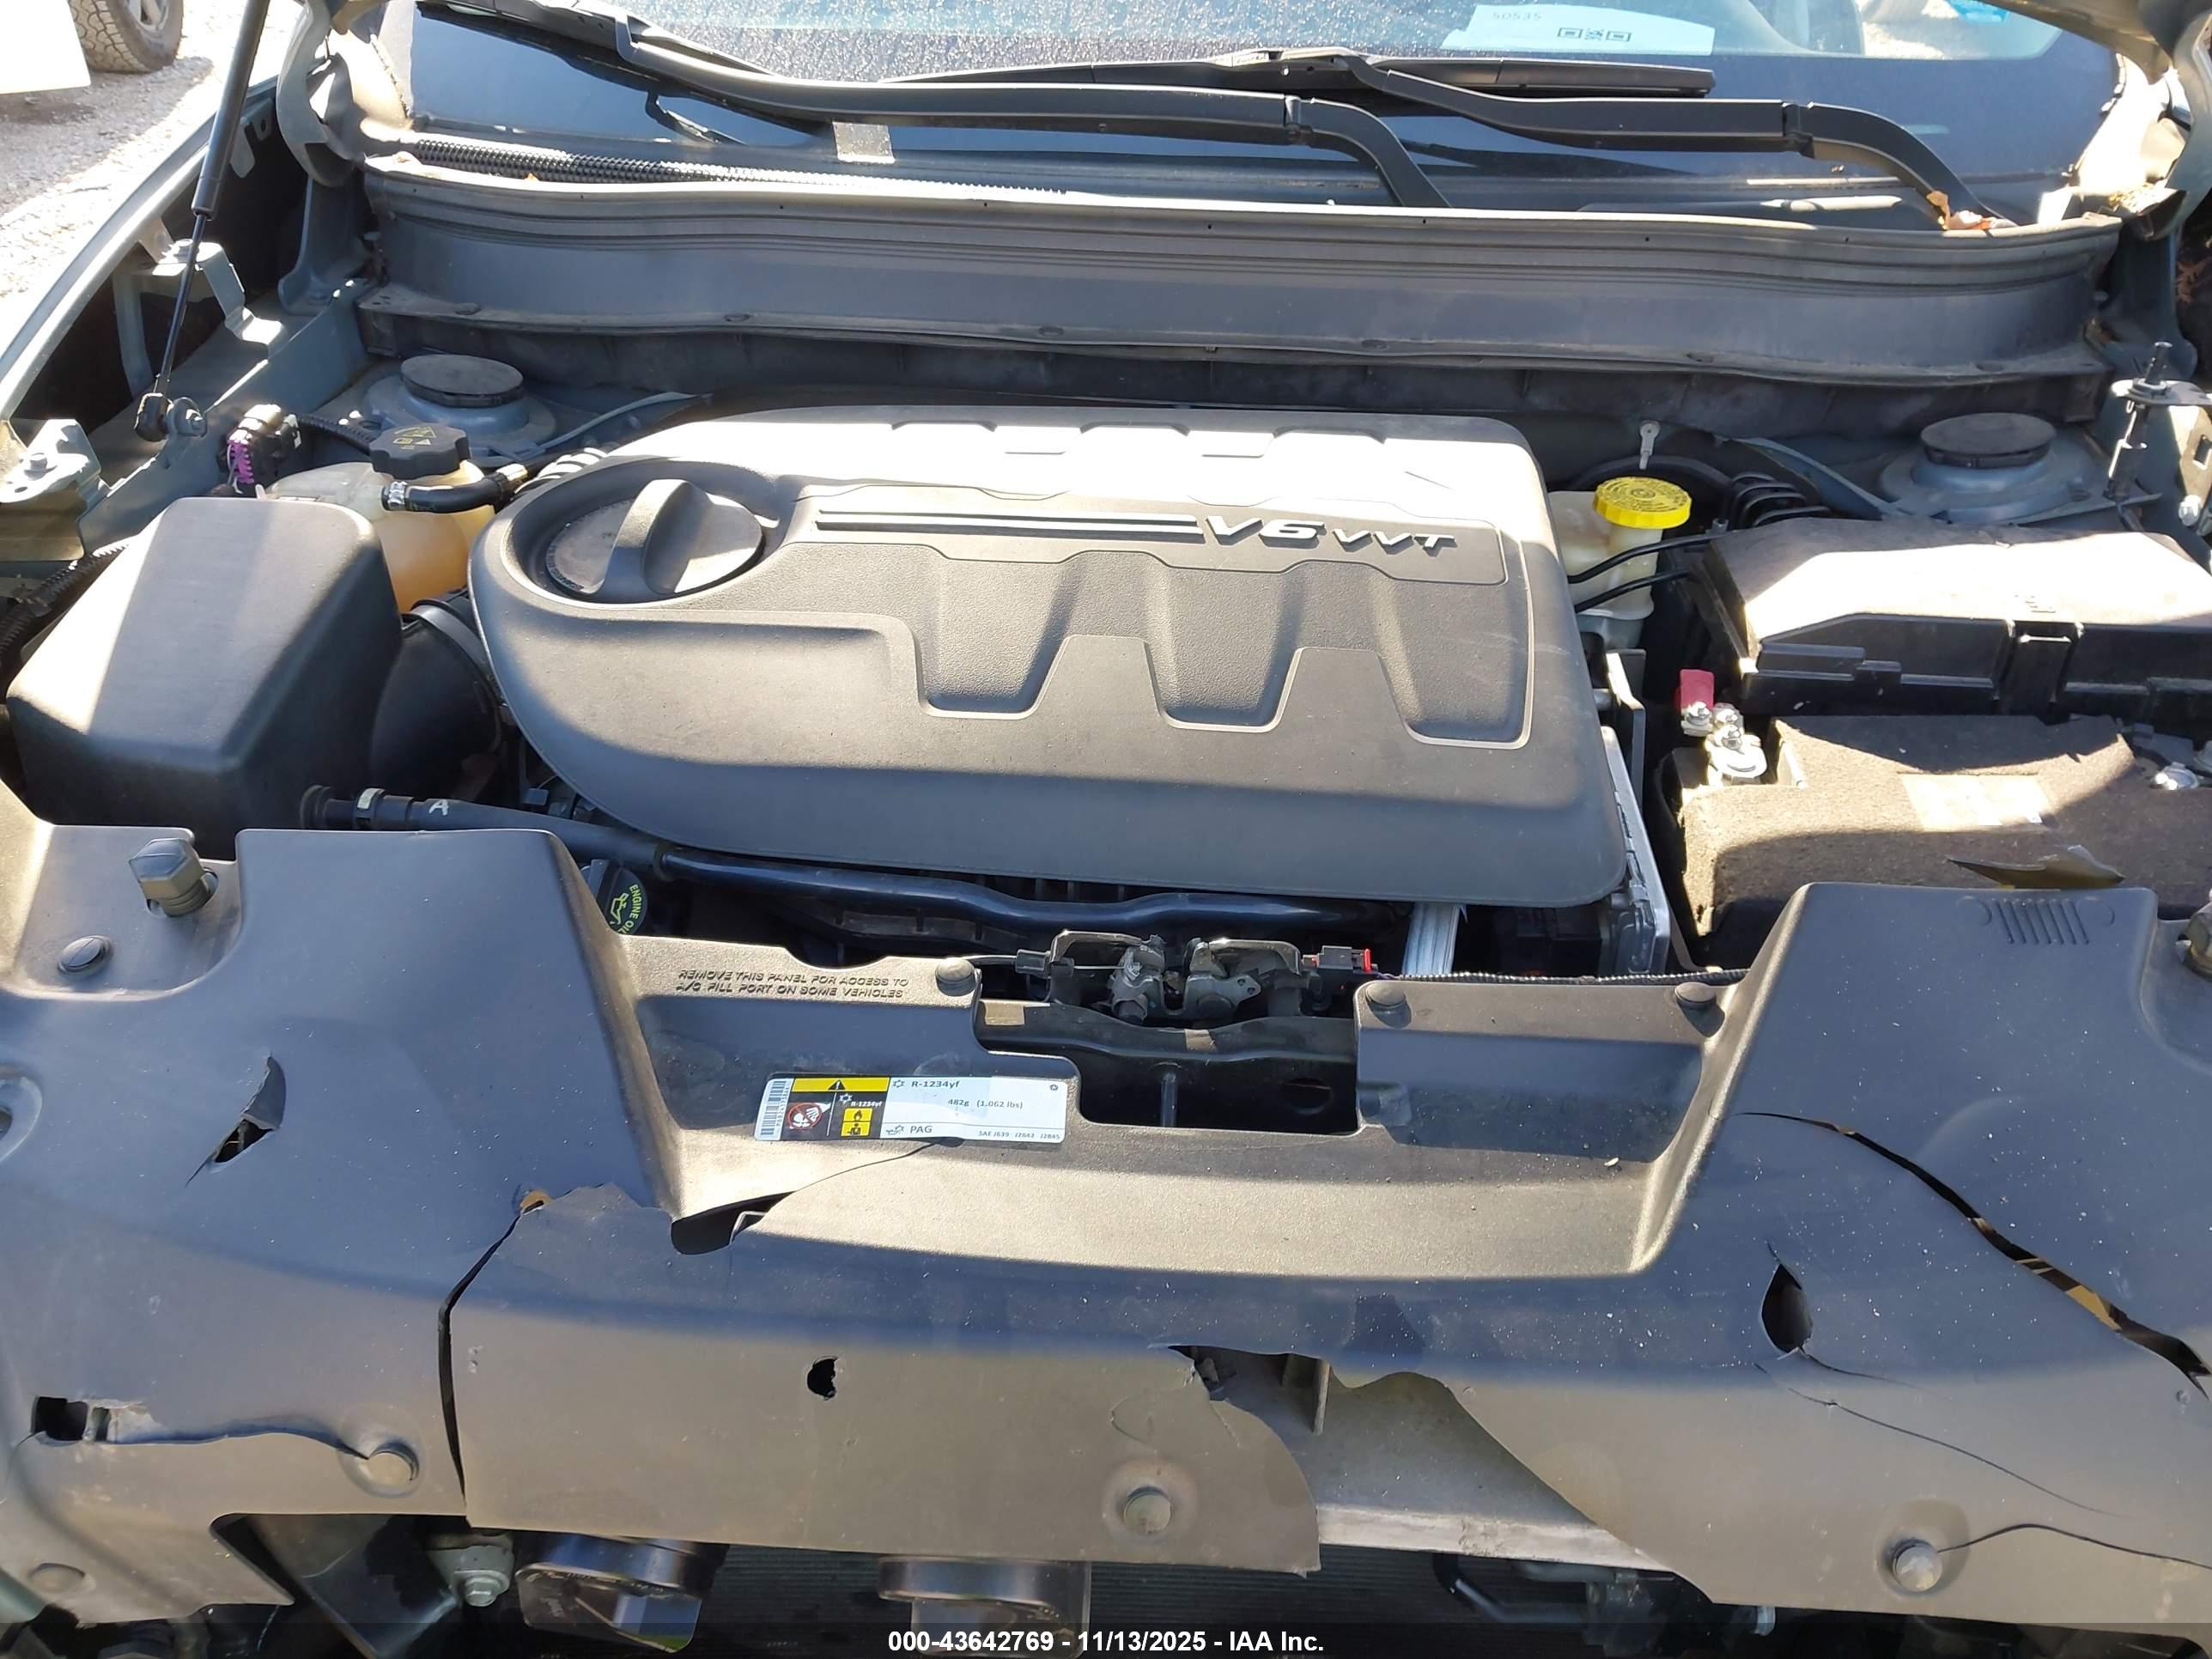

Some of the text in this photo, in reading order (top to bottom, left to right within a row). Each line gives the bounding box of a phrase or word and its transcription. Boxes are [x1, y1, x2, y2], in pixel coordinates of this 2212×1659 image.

[1205, 515, 1458, 556] V6 VVT
[629, 884, 642, 920] ENGINE
[678, 969, 908, 988] REMOVE THIS PANEL FOR ACCESS TO
[675, 981, 903, 998] A/C FILL PORT ON SOME VEHICLES
[911, 1080, 961, 1089] R-1234yf
[947, 1098, 1024, 1109] 482g (1.062 lbs)
[909, 1126, 933, 1134] PAG
